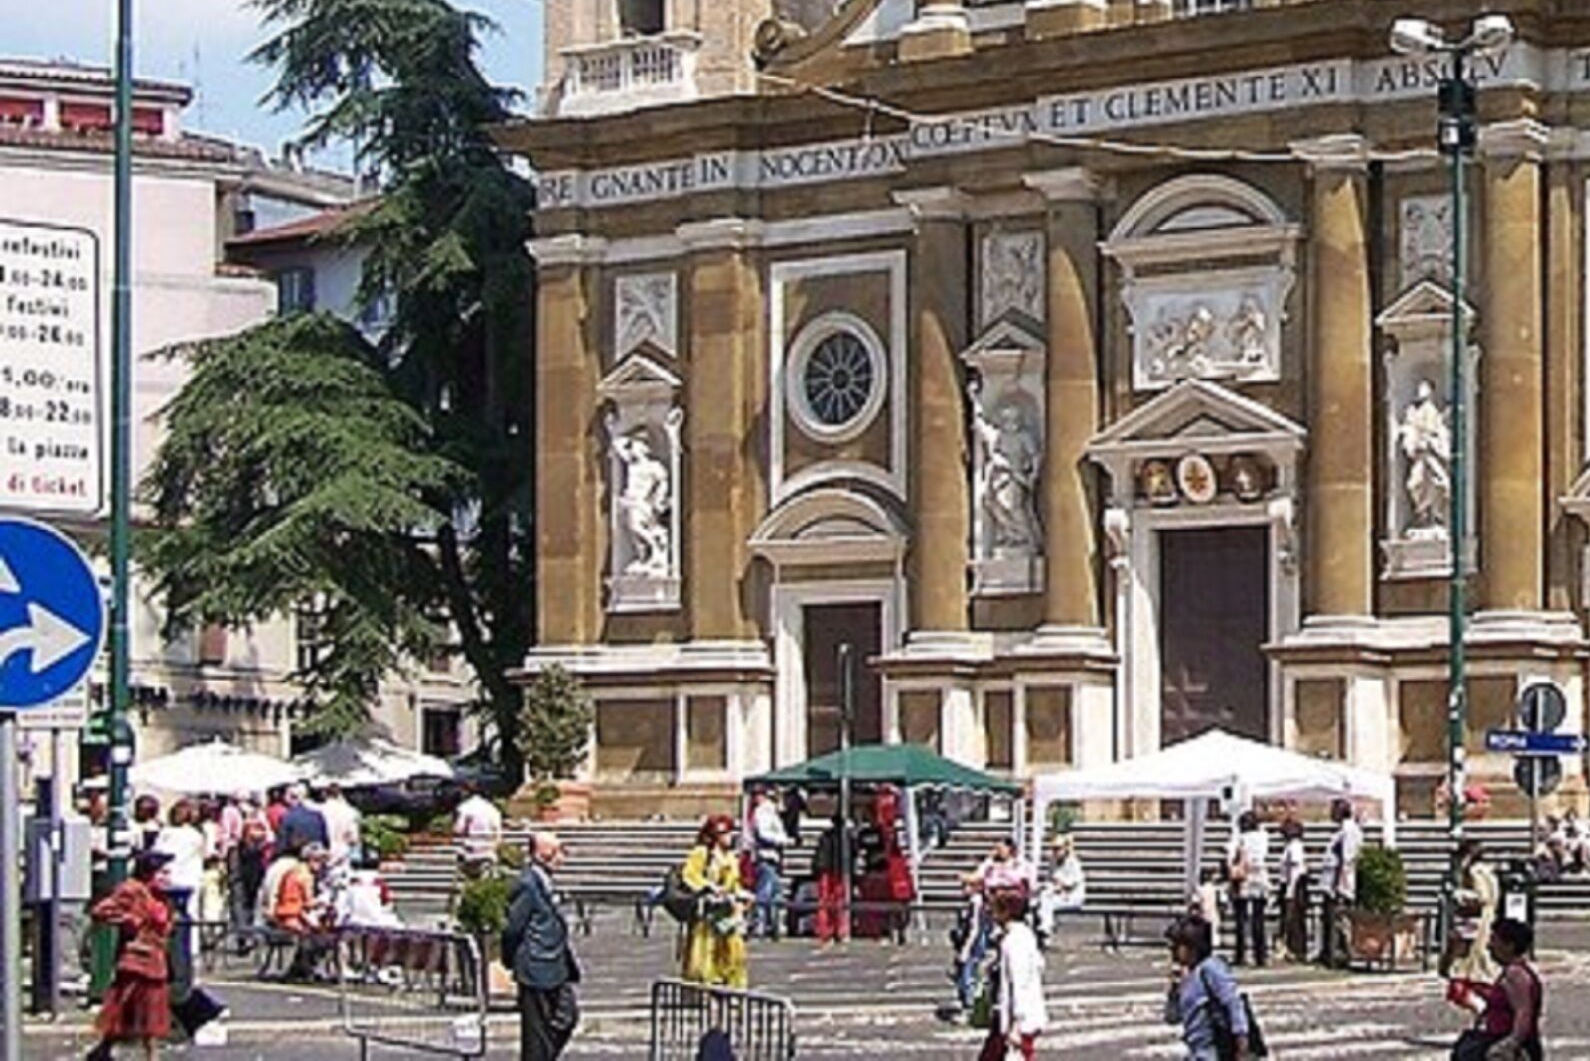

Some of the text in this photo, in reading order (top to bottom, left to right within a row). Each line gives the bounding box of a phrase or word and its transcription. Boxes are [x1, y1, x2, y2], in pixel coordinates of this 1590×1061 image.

[1050, 97, 1091, 129] ET
[1105, 72, 1287, 121] CLEMENTE
[1302, 66, 1338, 97] XI
